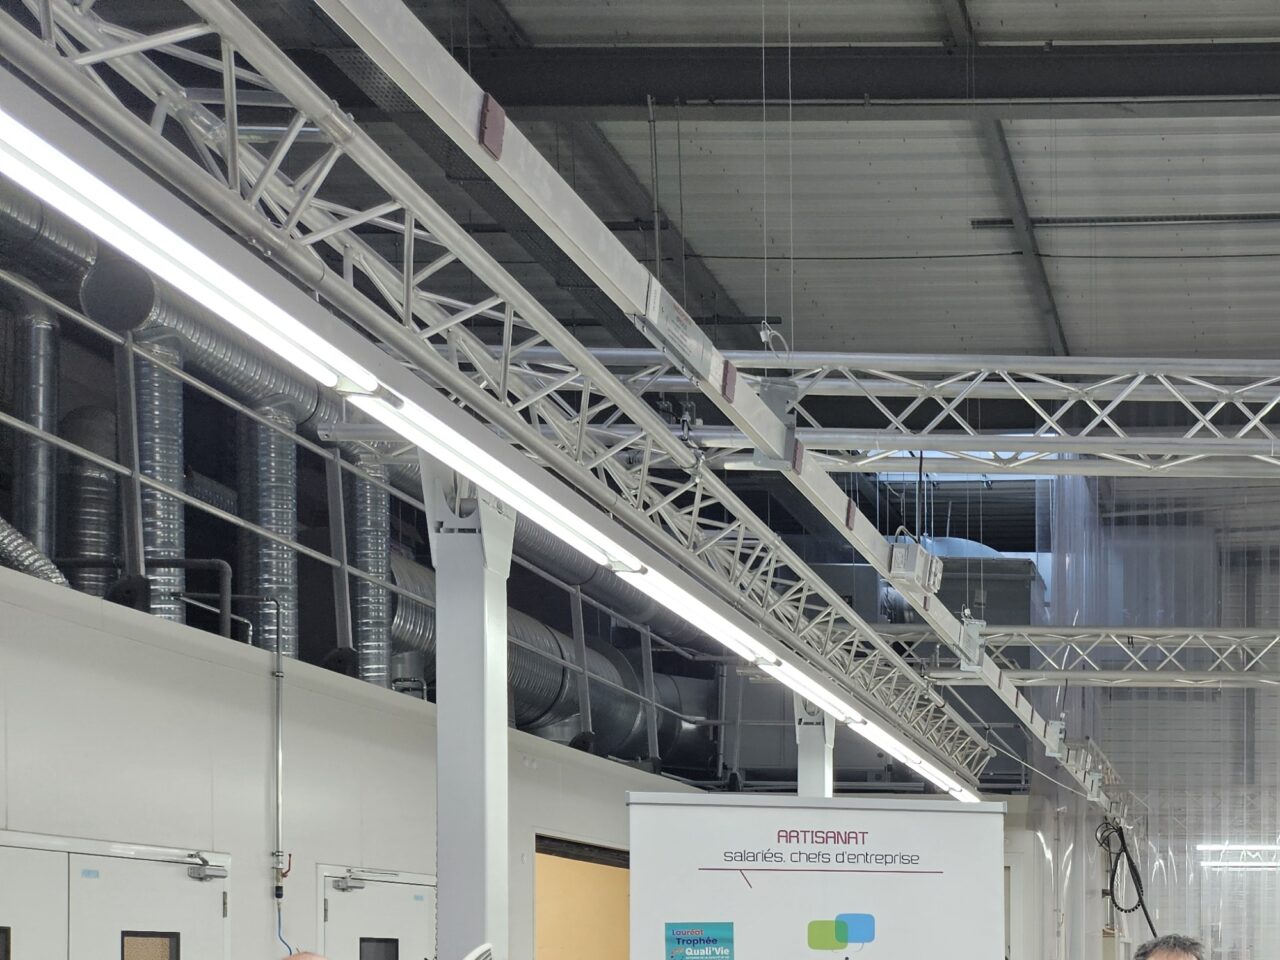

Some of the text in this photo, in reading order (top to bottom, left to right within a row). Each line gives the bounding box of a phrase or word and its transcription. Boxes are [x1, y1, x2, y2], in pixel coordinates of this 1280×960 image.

[777, 830, 868, 845] ARTISANAT
[790, 850, 831, 863] chefs
[835, 851, 920, 866] d'entreprise
[676, 937, 718, 946] Trophée
[685, 947, 730, 956] Quali'Vie
